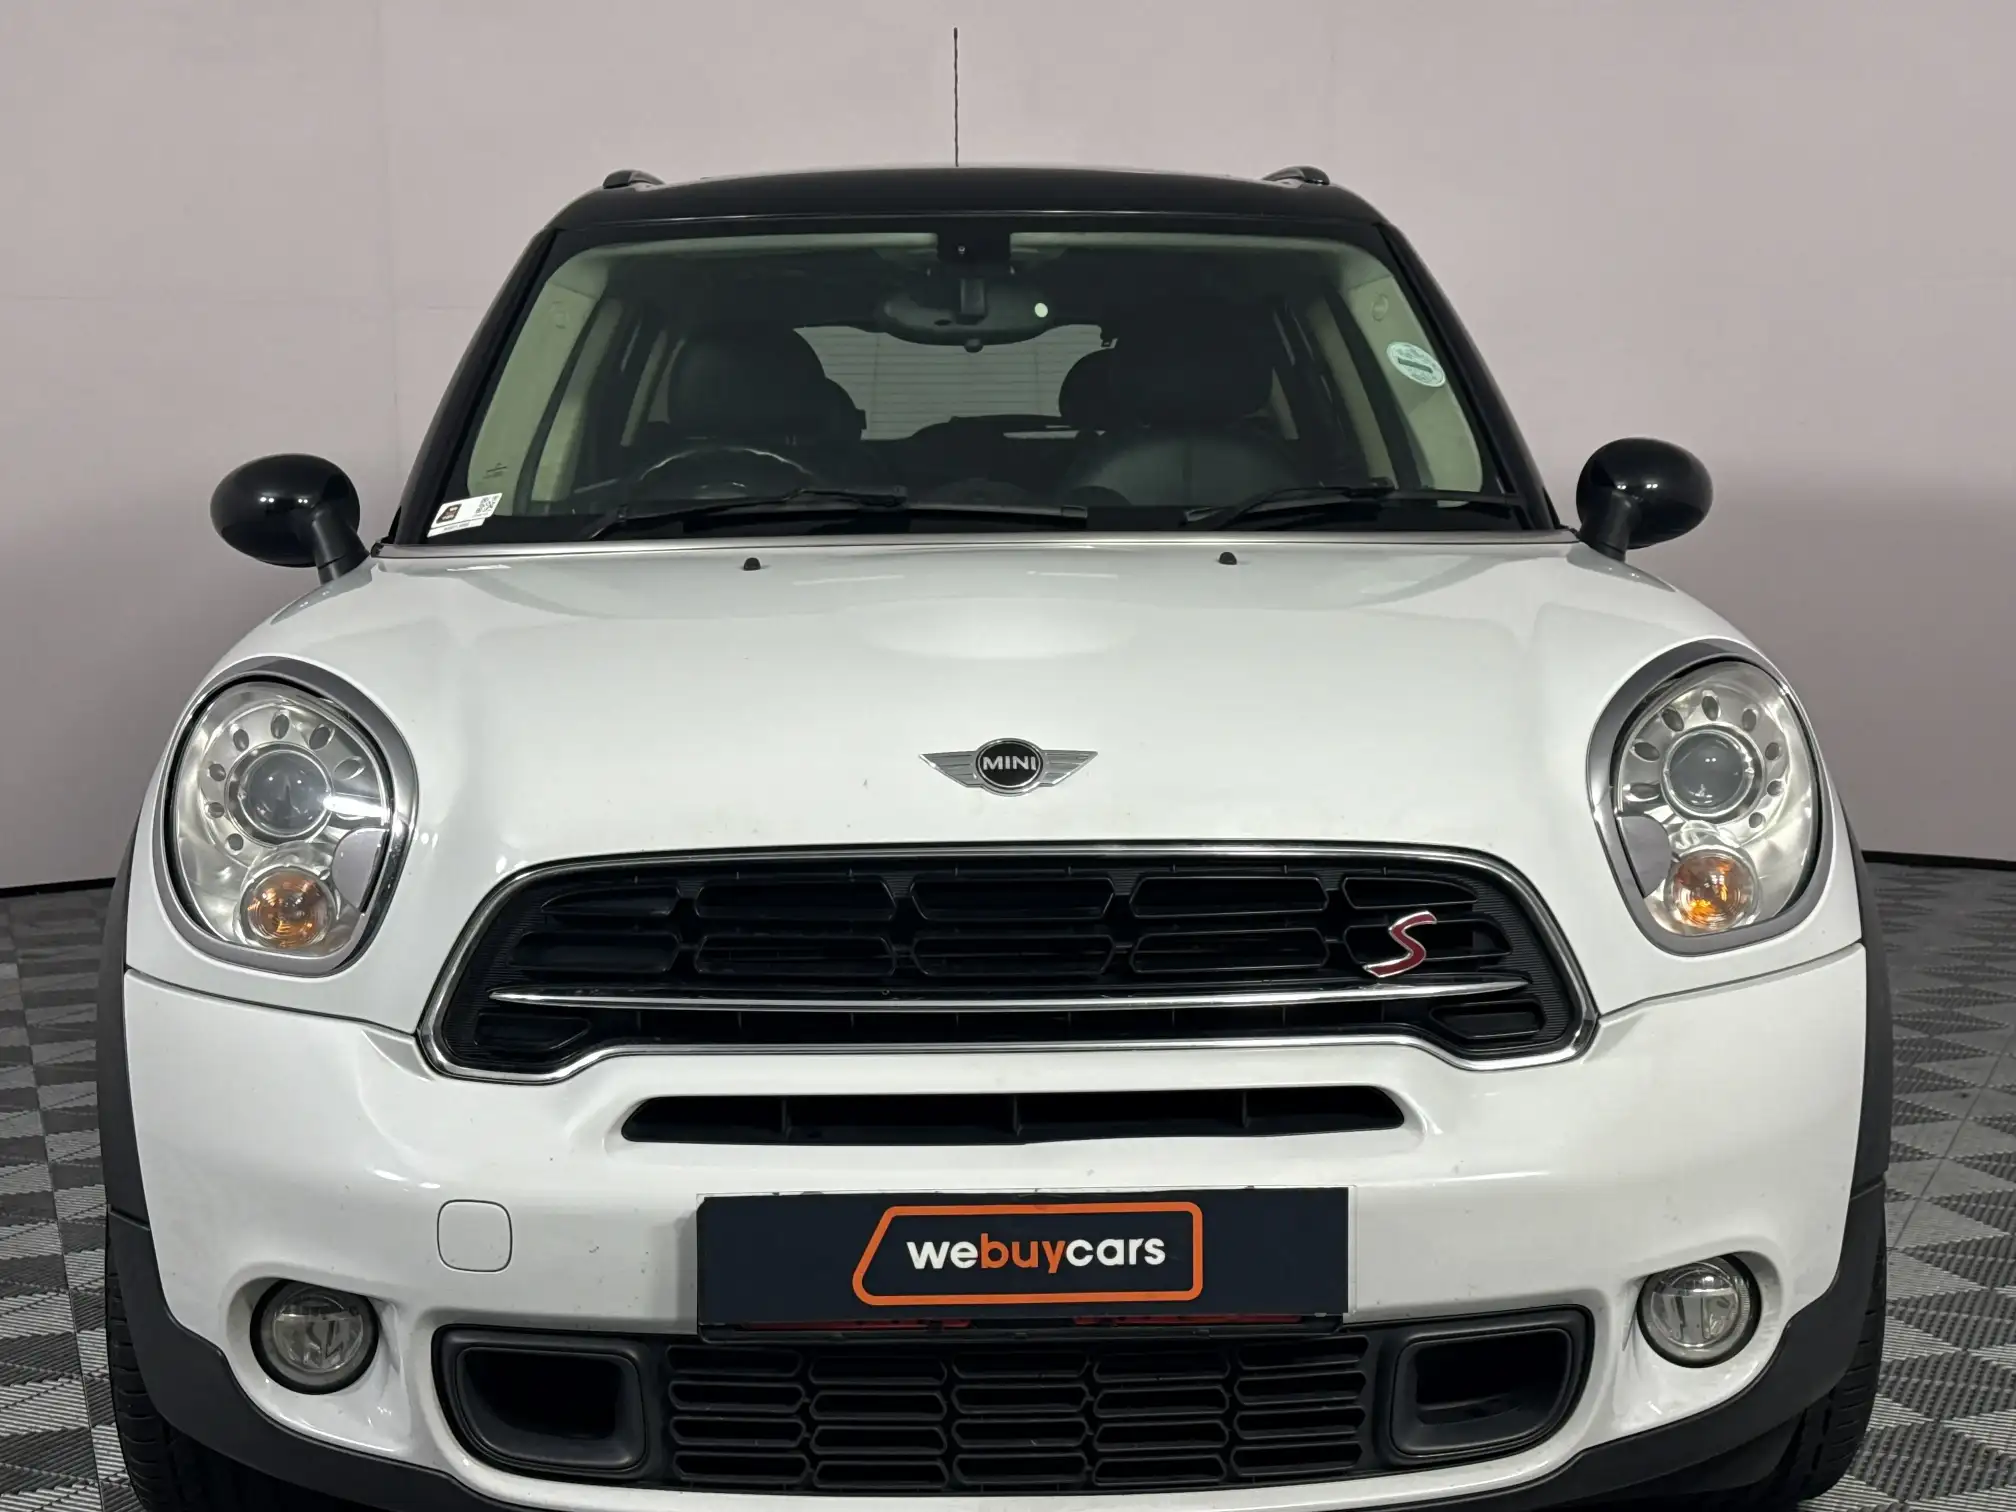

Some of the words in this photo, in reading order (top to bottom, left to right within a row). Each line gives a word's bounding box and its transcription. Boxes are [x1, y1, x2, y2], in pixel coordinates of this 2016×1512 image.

[982, 755, 1037, 771] MINI
[1362, 910, 1438, 978] S
[906, 1232, 1166, 1274] webuycars
